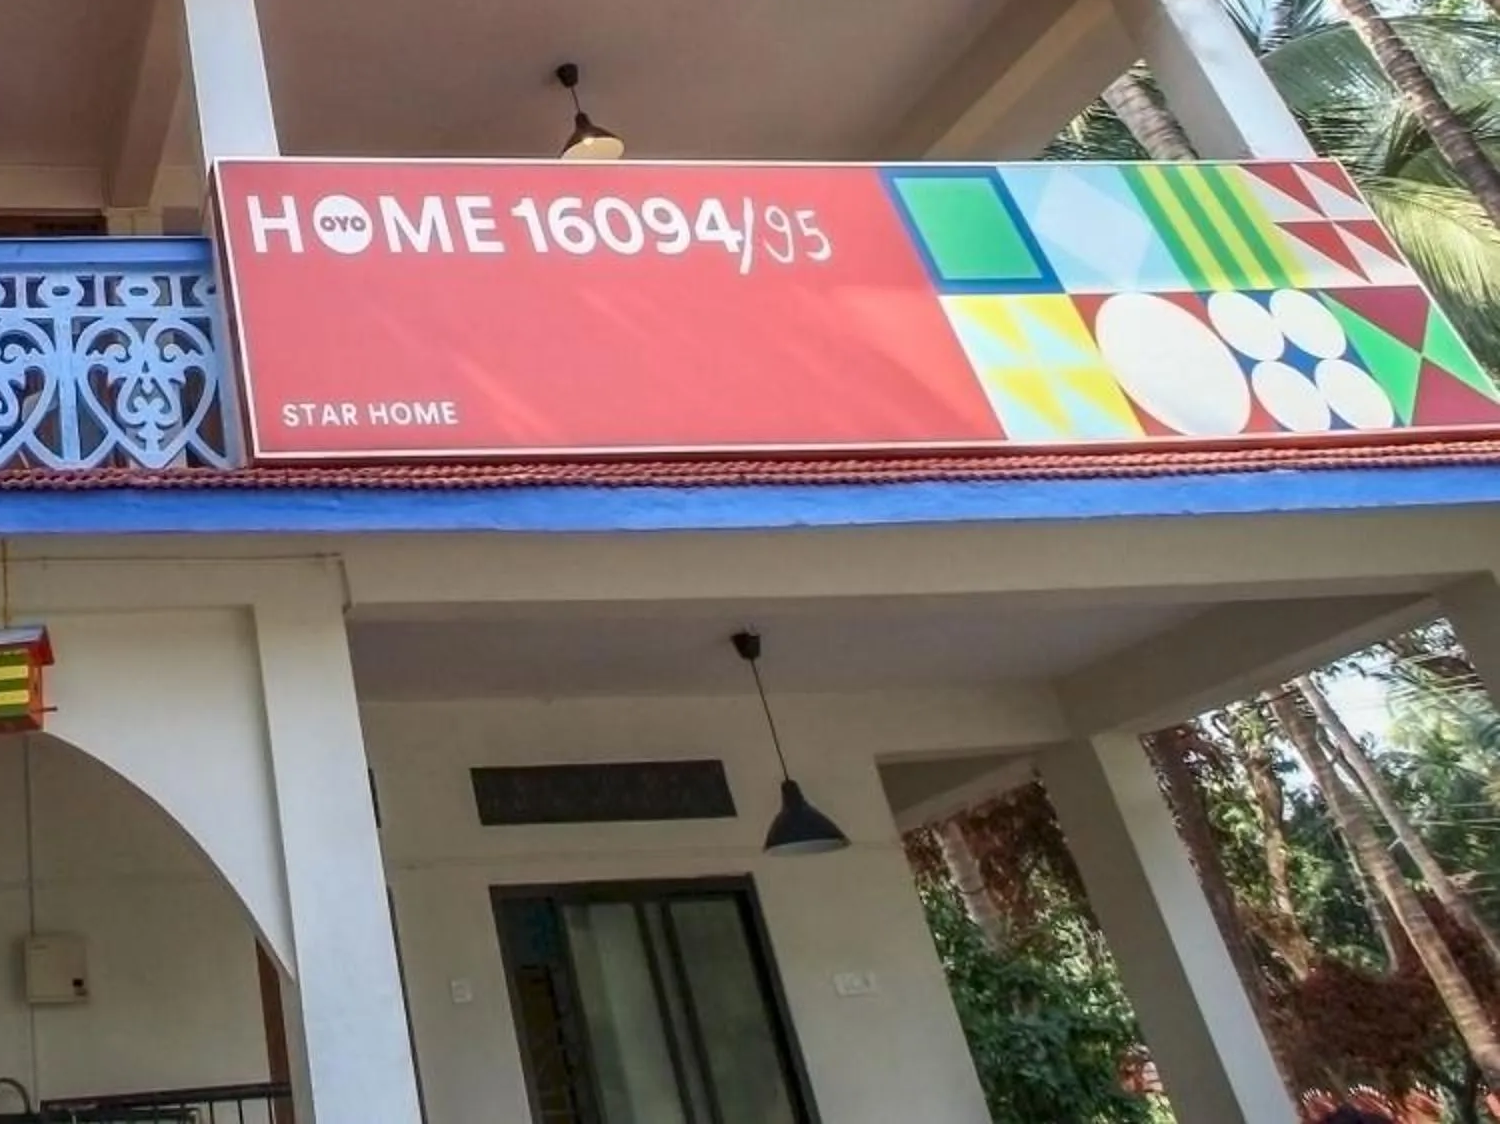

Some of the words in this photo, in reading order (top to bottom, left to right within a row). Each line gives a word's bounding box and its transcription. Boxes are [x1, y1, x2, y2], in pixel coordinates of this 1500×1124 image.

[320, 215, 367, 232] OYO
[282, 403, 359, 426] STAR
[367, 401, 460, 425] HOME
